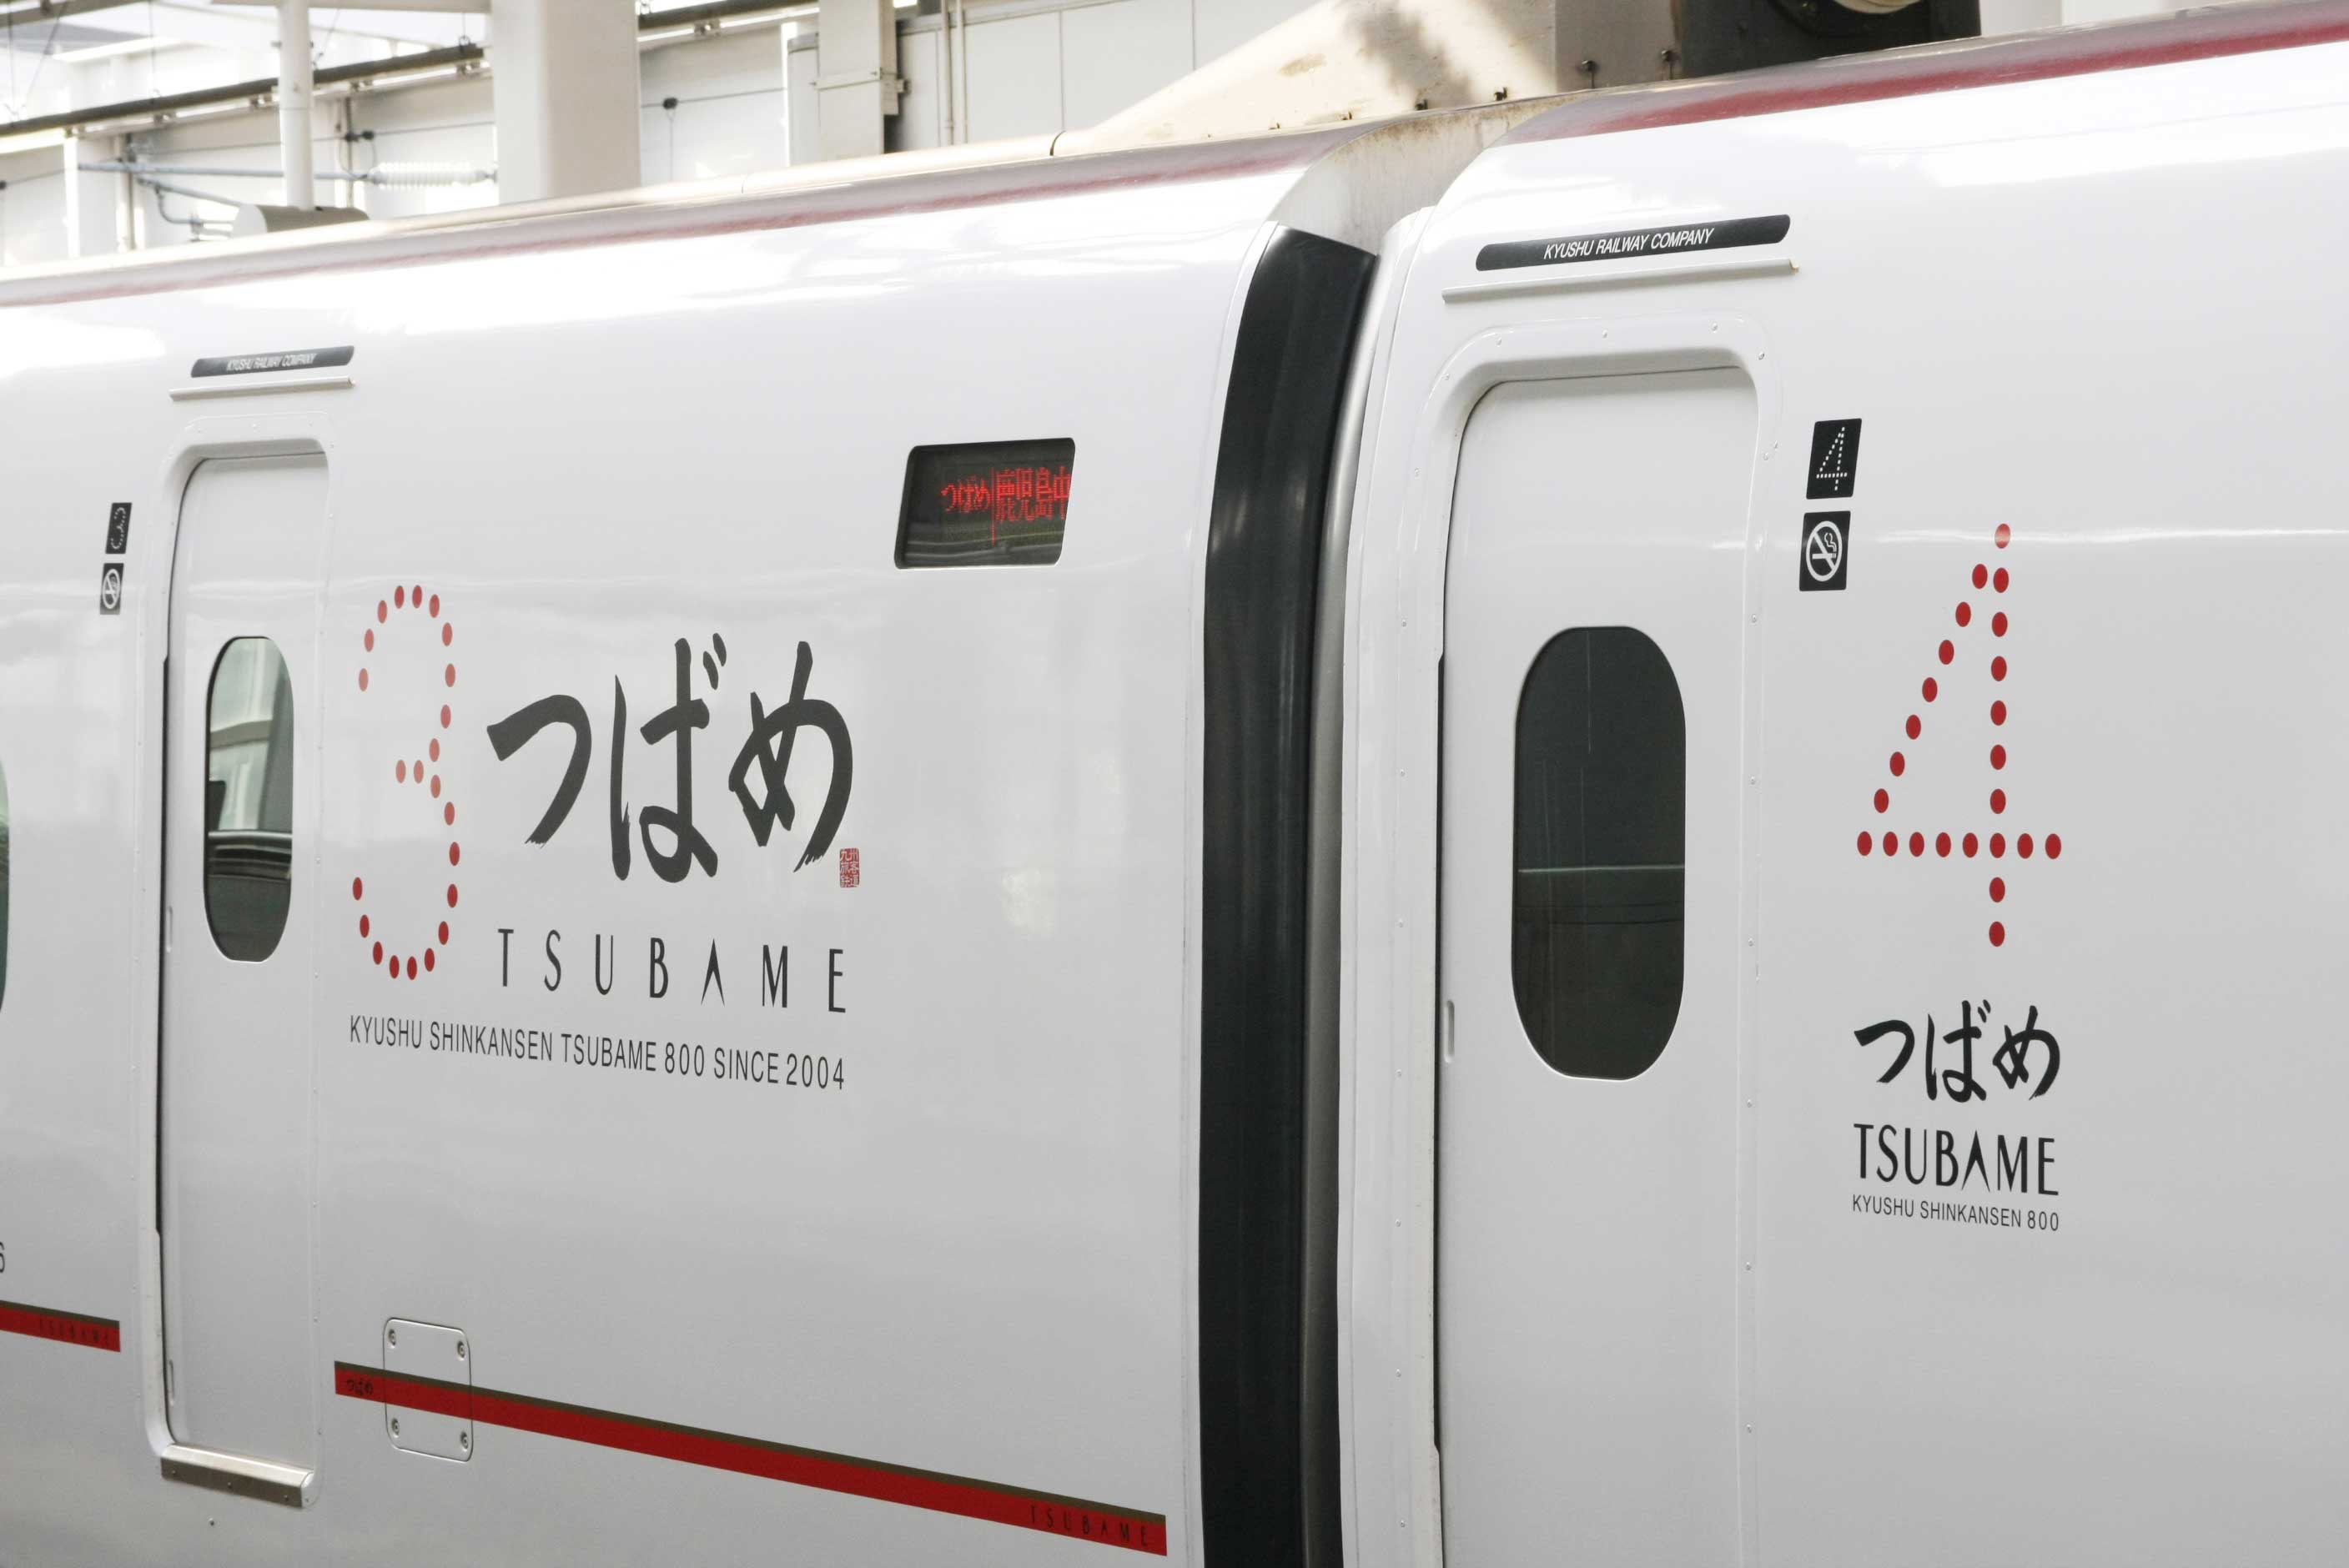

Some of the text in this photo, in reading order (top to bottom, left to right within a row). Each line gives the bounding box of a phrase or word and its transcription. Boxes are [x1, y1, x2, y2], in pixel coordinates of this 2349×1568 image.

[1542, 227, 1715, 260] KYUSHU RAILWAY COMPANY
[1816, 425, 1848, 491] 4
[486, 632, 853, 884] つばめ
[1857, 523, 2062, 947] 4
[352, 585, 460, 981] 3
[497, 927, 847, 1013] TSUBAME
[350, 1014, 845, 1091] KYUSHU SHINKANSEN TSUBAME 800 SINCE 2004
[1854, 999, 2060, 1103] つばめ
[1853, 1123, 2059, 1196] TSUBAME
[1852, 1194, 2060, 1232] KYUSHU SHINKANSEN 800
[1030, 1505, 1147, 1547] TSUBAME
